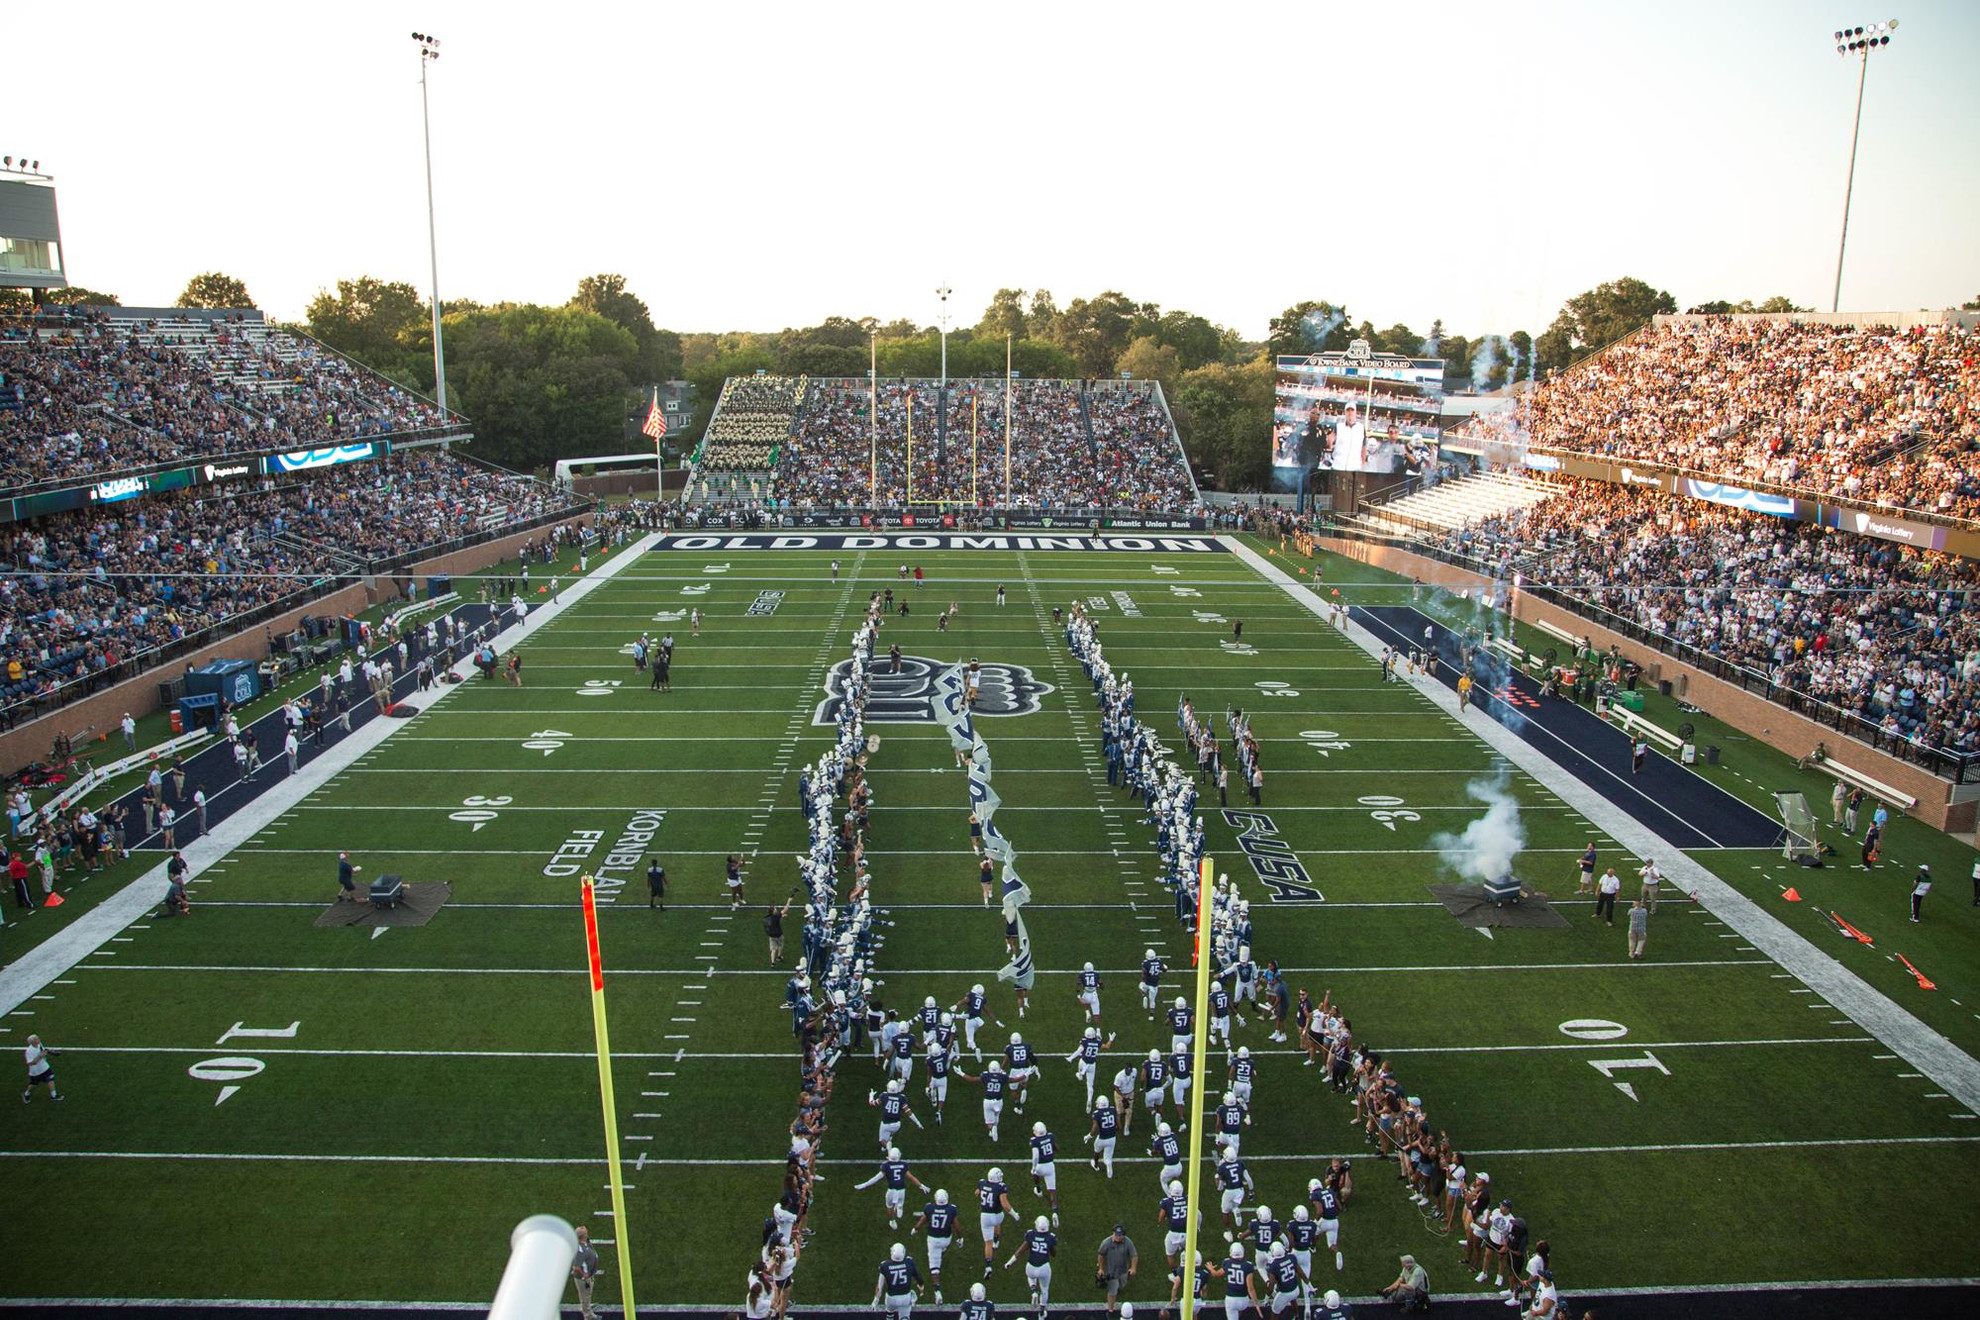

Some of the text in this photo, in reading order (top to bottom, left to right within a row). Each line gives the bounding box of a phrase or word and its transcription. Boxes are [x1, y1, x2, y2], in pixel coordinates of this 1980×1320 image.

[707, 517, 724, 525] COX
[1112, 519, 1191, 528] Atlantic Union Bank
[671, 537, 1213, 551] OLD DOMINION
[576, 679, 622, 696] 50
[522, 729, 573, 750] 40
[448, 795, 513, 822] 30
[1358, 795, 1421, 822] 30
[543, 829, 604, 877] FIELD
[1149, 965, 1159, 976] 45
[1085, 975, 1095, 986] 14
[974, 998, 982, 1010] 9
[1216, 996, 1227, 1009] 97
[926, 1013, 937, 1024] 21
[1175, 1015, 1187, 1027] 57
[940, 1031, 947, 1041] 7
[188, 1021, 300, 1080] 10
[900, 1043, 907, 1053] 2
[1085, 1046, 1098, 1058] 83
[1559, 1019, 1671, 1077] 10
[1013, 1049, 1026, 1062] 69
[936, 1063, 943, 1073] 8
[1178, 1059, 1186, 1072] 8
[1237, 1064, 1250, 1076] 23
[1150, 1068, 1162, 1080] 13
[987, 1082, 1000, 1093] 99
[885, 1100, 899, 1114] 48
[1101, 1114, 1115, 1128] 29
[1226, 1112, 1240, 1125] 89
[1040, 1142, 1052, 1156] 19
[1163, 1141, 1178, 1157] 88
[893, 1168, 901, 1180] 5
[1229, 1168, 1238, 1183] 5
[981, 1190, 993, 1208] 54
[1322, 1194, 1334, 1209] 12
[1172, 1206, 1187, 1220] 55
[931, 1214, 948, 1229] 67
[1257, 1229, 1271, 1244] 19
[1299, 1231, 1307, 1243] 2
[1031, 1241, 1048, 1254] 92
[890, 1269, 908, 1286] 75
[1227, 1268, 1244, 1285] 20
[1280, 1264, 1296, 1283] 25
